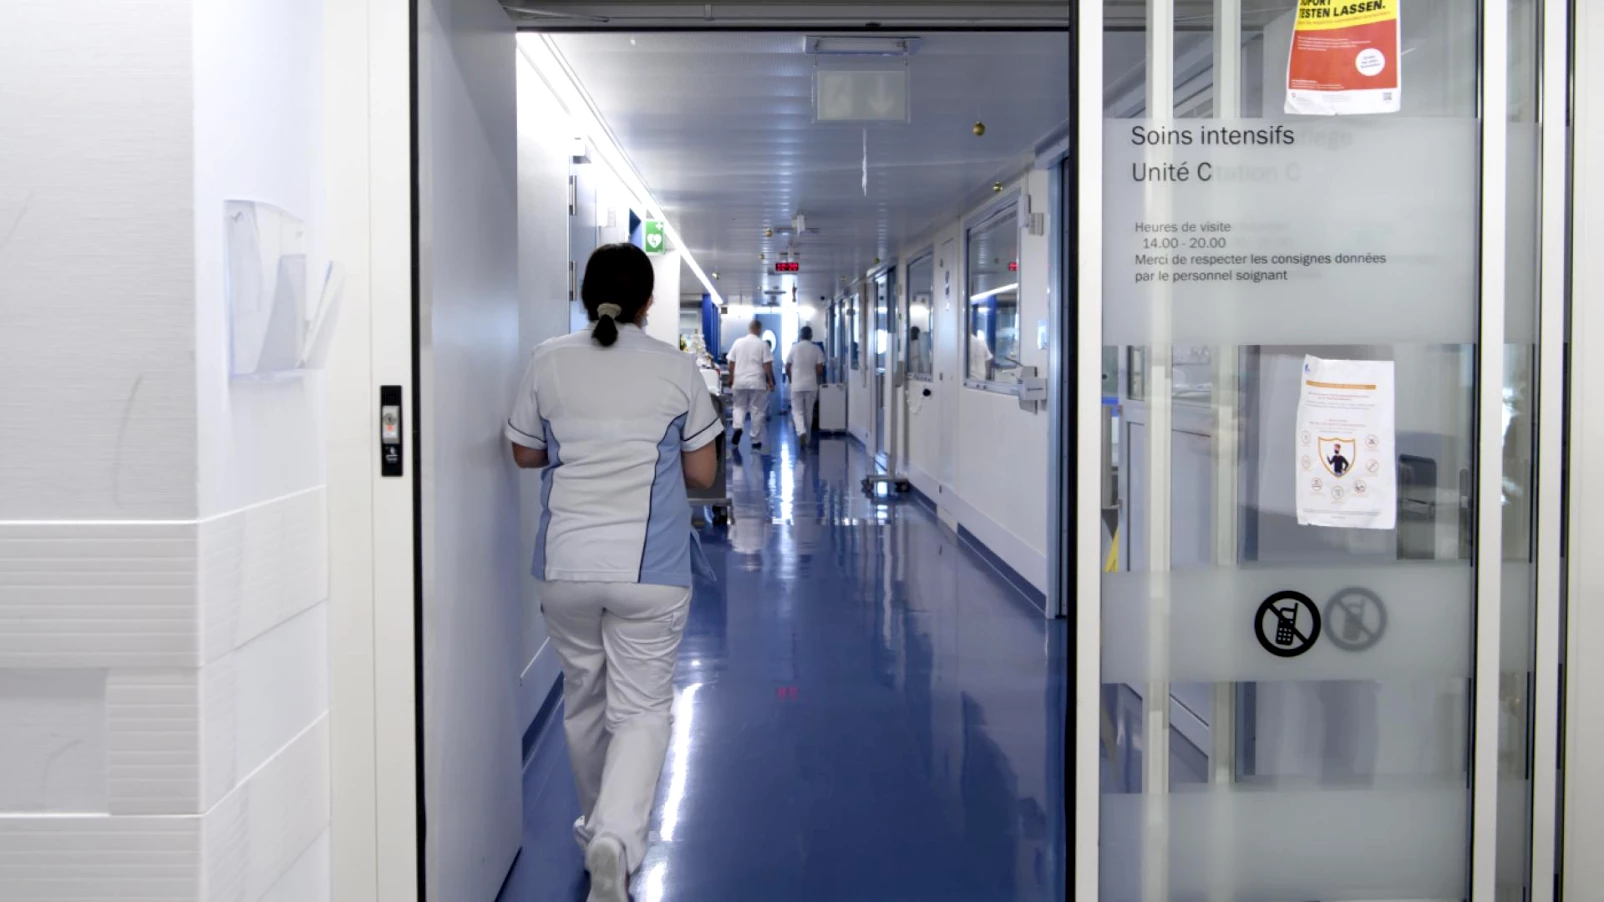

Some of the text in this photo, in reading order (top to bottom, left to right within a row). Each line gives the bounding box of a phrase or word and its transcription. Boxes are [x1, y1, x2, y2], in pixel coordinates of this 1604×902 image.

[1333, 0, 1386, 17] LASSEN.
[1131, 125, 1193, 145] Soins
[1200, 125, 1295, 145] intensifs
[1132, 161, 1212, 181] Unité C
[1135, 222, 1178, 232] Heures
[1181, 222, 1197, 232] de
[1200, 222, 1231, 232] visite
[1143, 238, 1179, 248] 14.00
[1189, 237, 1227, 248] 20.00
[1135, 254, 1168, 265] Merci
[1172, 254, 1187, 265] de
[1190, 255, 1247, 266] respecter
[1250, 254, 1268, 264] les
[1271, 253, 1332, 266] consignes
[1334, 252, 1387, 264] données
[1135, 272, 1155, 283] par
[1158, 270, 1169, 281] le
[1172, 270, 1233, 282] personnel
[1236, 270, 1288, 283] soignant
